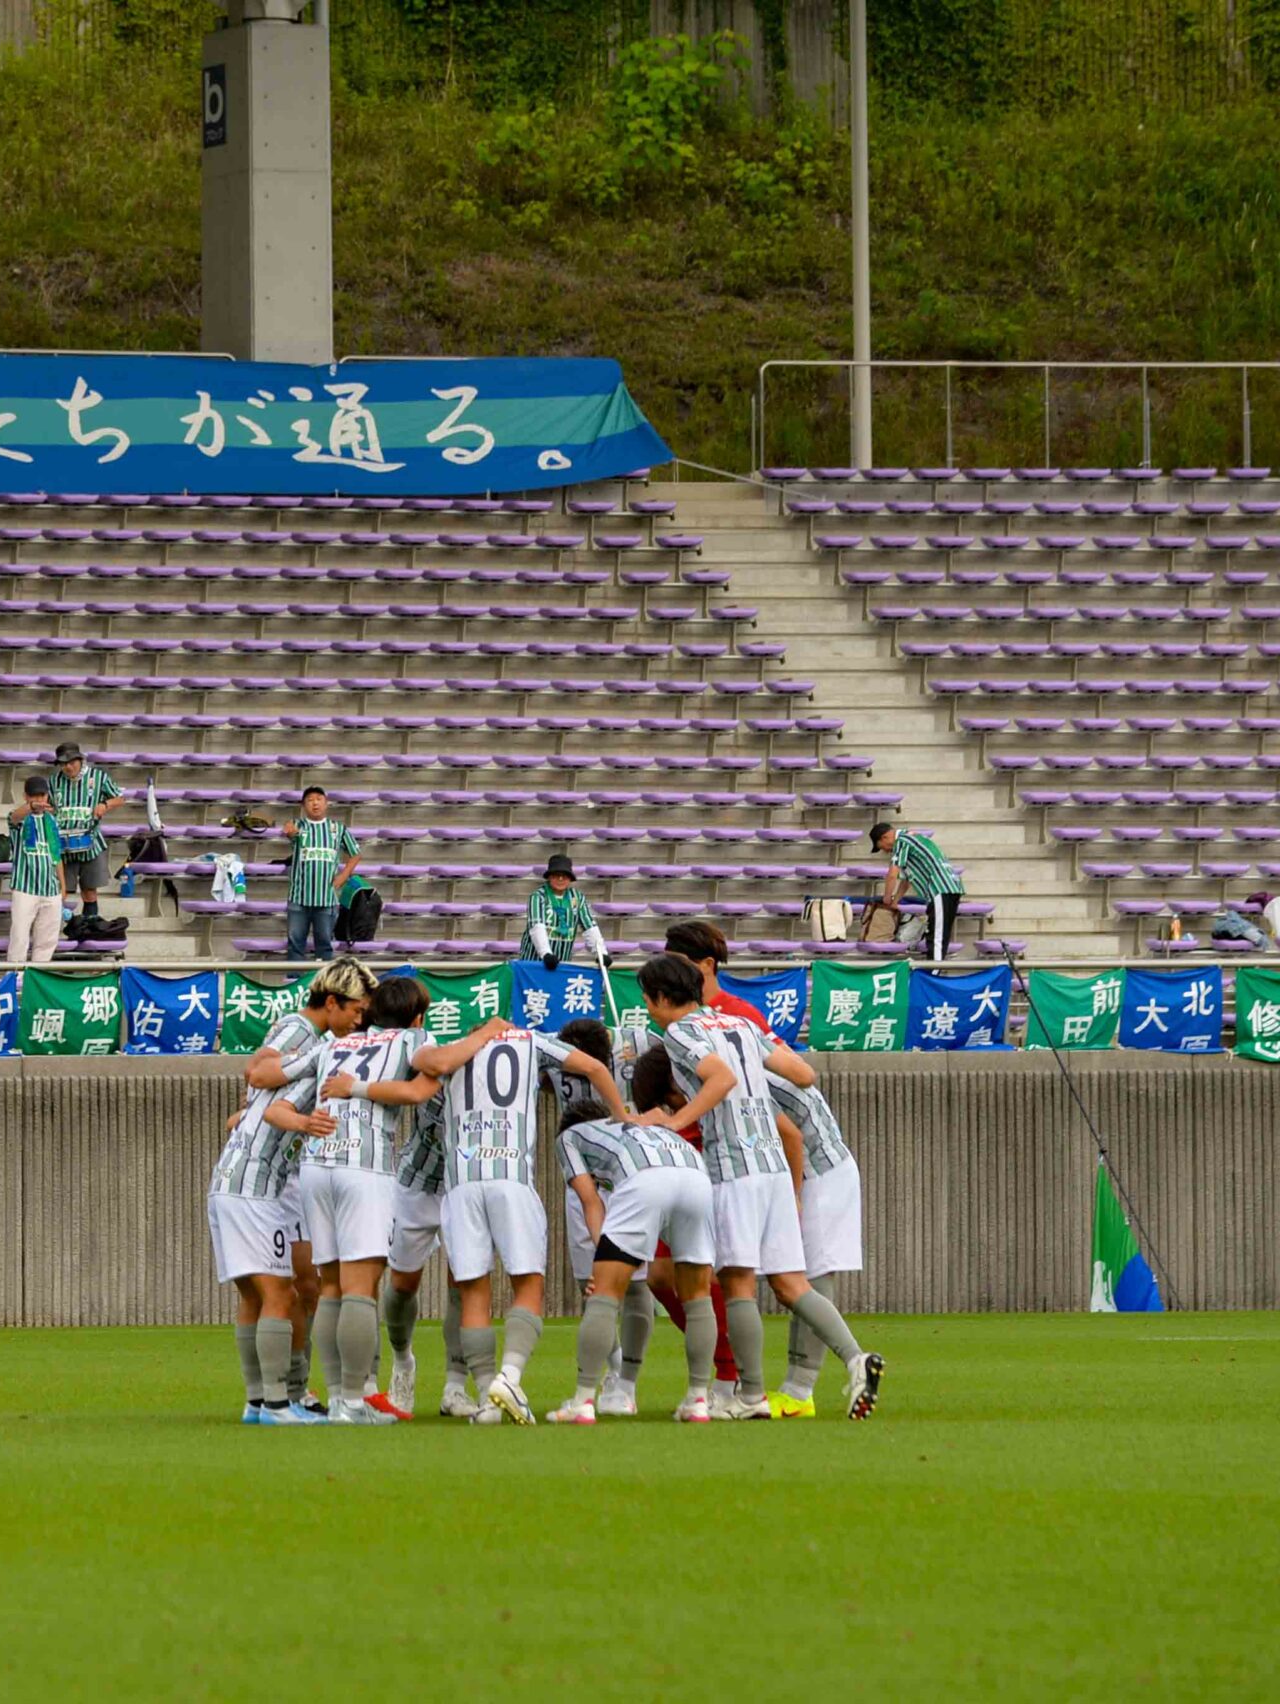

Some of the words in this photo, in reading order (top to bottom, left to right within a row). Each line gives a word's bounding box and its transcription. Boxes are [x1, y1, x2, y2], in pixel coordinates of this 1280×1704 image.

[204, 72, 224, 123] b
[563, 973, 596, 1015] 森
[765, 988, 799, 1028] 深
[464, 1044, 520, 1111] 10
[463, 1120, 513, 1133] KANTA
[273, 1229, 286, 1258] 9
